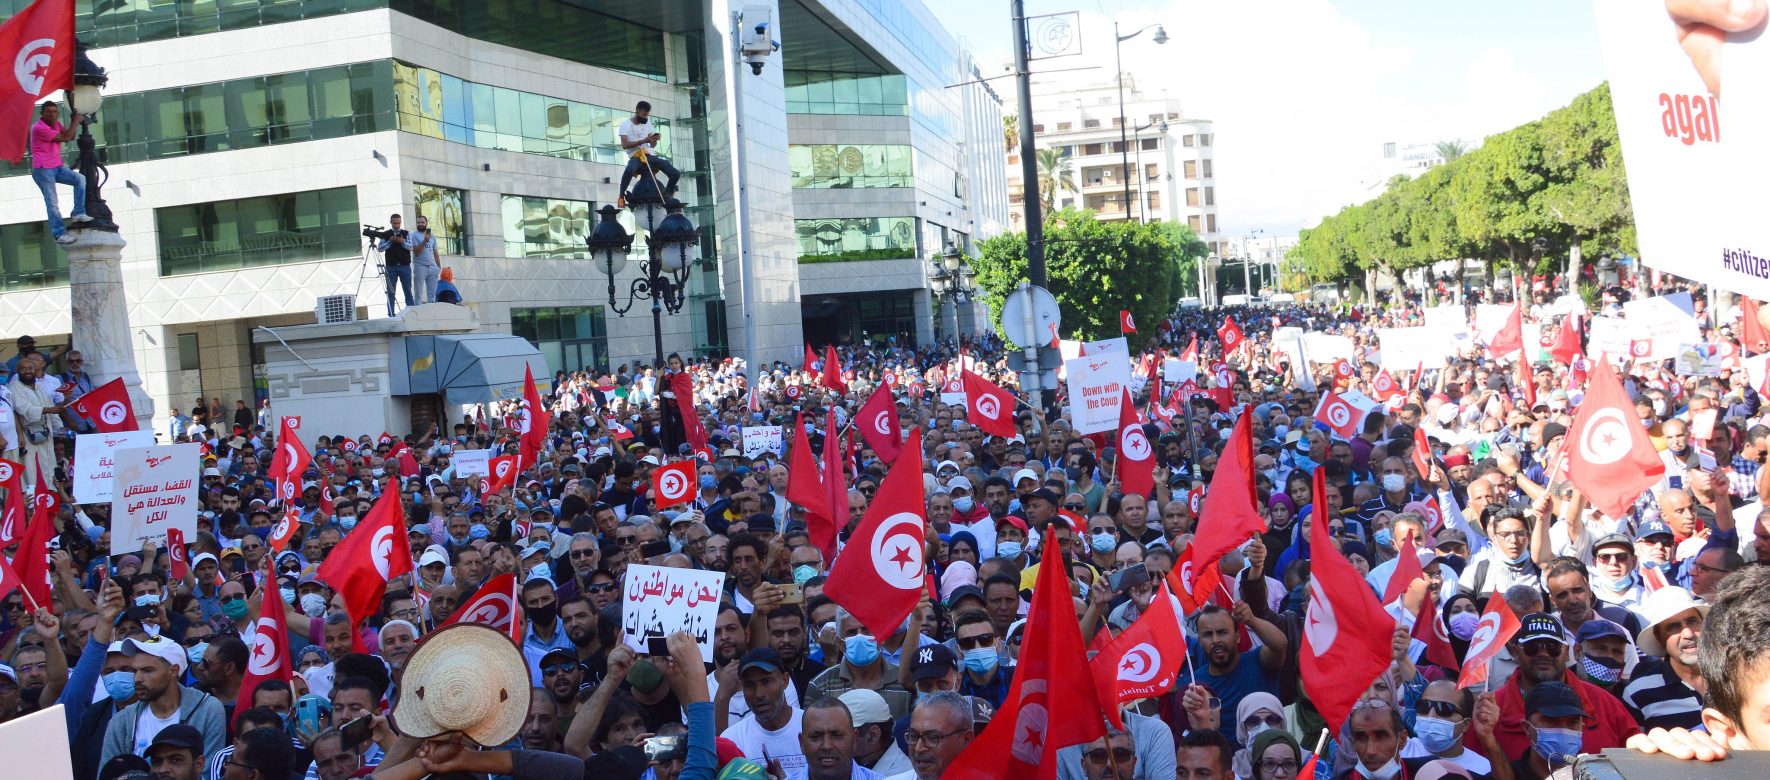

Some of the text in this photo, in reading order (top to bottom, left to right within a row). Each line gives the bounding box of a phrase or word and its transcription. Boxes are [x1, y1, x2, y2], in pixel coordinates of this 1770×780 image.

[1722, 247, 1770, 280] #citize
[1082, 385, 1103, 397] Down
[1103, 382, 1120, 394] with
[1087, 396, 1119, 410] the Coup
[123, 478, 192, 498] القضاء مستقل
[127, 494, 186, 516] والعدالة هي
[146, 510, 168, 524] الكل
[629, 569, 720, 608] نحن مواطنون
[625, 608, 665, 646] حشرات
[1528, 622, 1557, 633] ITALIA
[919, 647, 933, 664] NY
